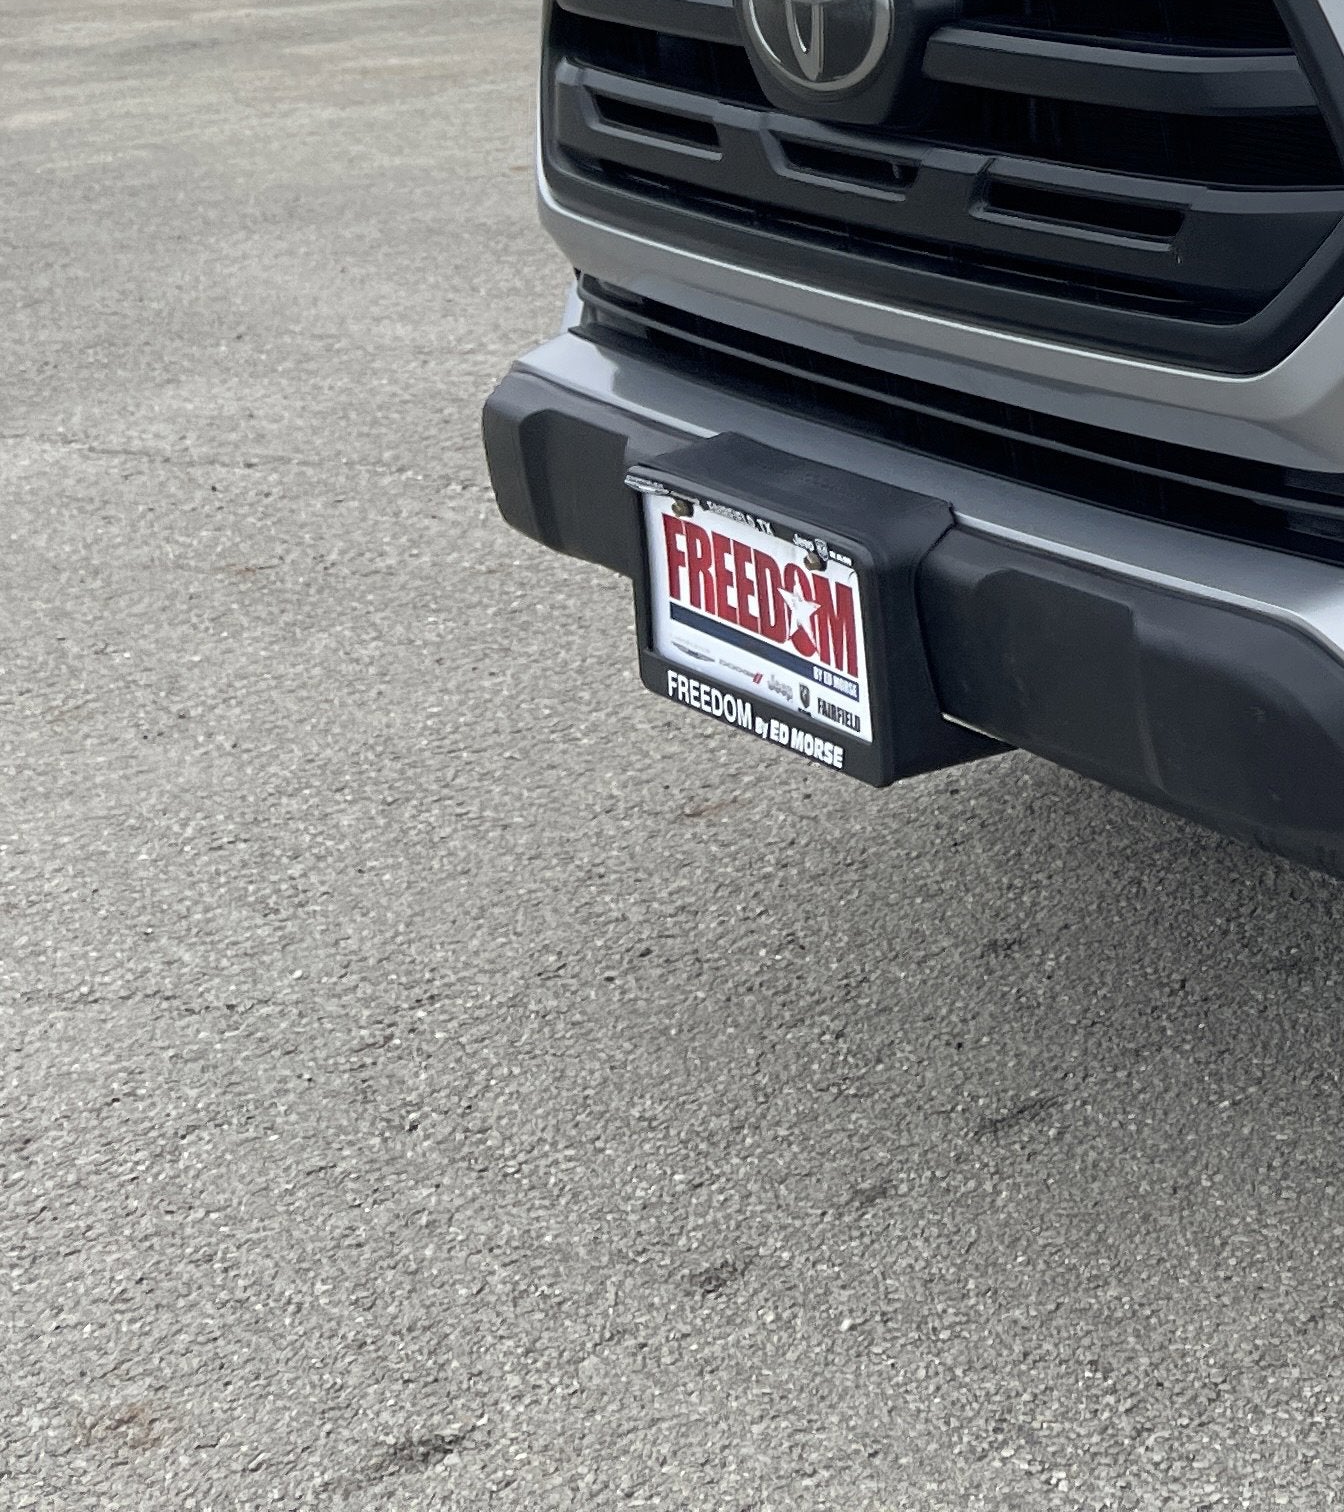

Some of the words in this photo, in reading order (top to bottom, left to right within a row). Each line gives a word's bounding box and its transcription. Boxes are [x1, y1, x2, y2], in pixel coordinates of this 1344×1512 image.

[662, 513, 859, 679] FREEDOM
[667, 669, 753, 731] FREEDOM
[769, 718, 791, 746] ED
[790, 727, 845, 770] MORSE
